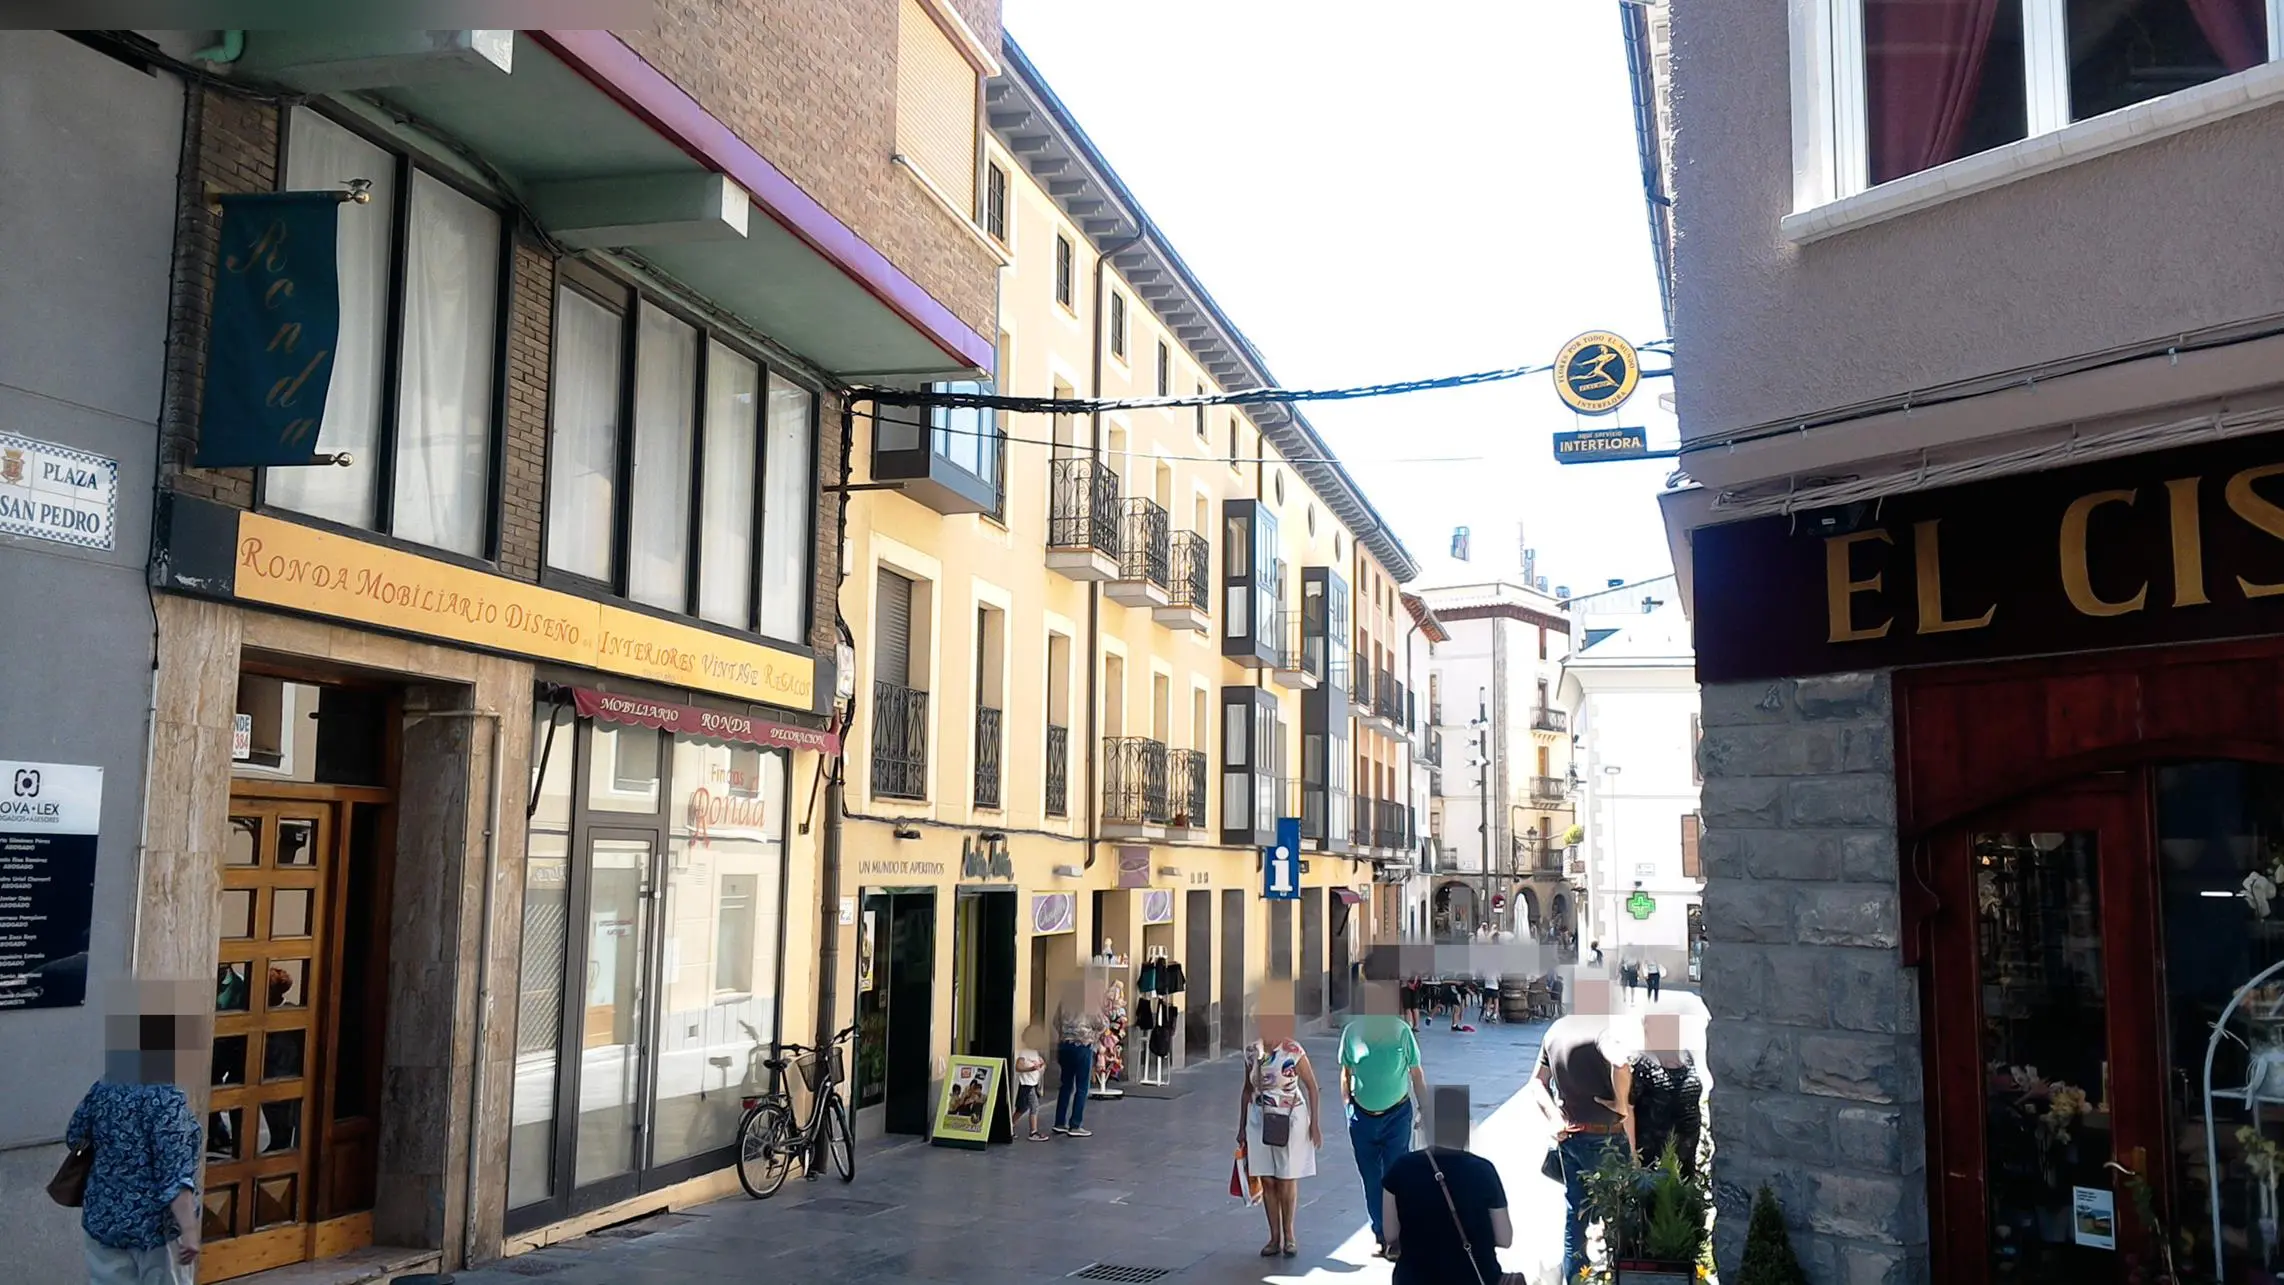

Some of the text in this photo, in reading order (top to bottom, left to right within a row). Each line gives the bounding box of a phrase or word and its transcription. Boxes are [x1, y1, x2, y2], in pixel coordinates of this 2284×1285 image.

[1568, 341, 1581, 354] POR
[1583, 335, 1604, 343] TODO
[1620, 343, 1635, 369] MUNDO
[1577, 391, 1626, 409] INTERFLORA
[1560, 437, 1641, 452] INTERFLORA
[43, 462, 98, 490] PLAZA
[0, 495, 100, 534] SAN PEDRO
[1824, 519, 1997, 643] EL
[601, 698, 679, 721] MOBILIARIO
[701, 712, 752, 734] RONDA
[688, 787, 766, 848] Ronda
[859, 861, 871, 874] UN
[872, 861, 899, 874] MUNDO
[900, 861, 908, 874] DE
